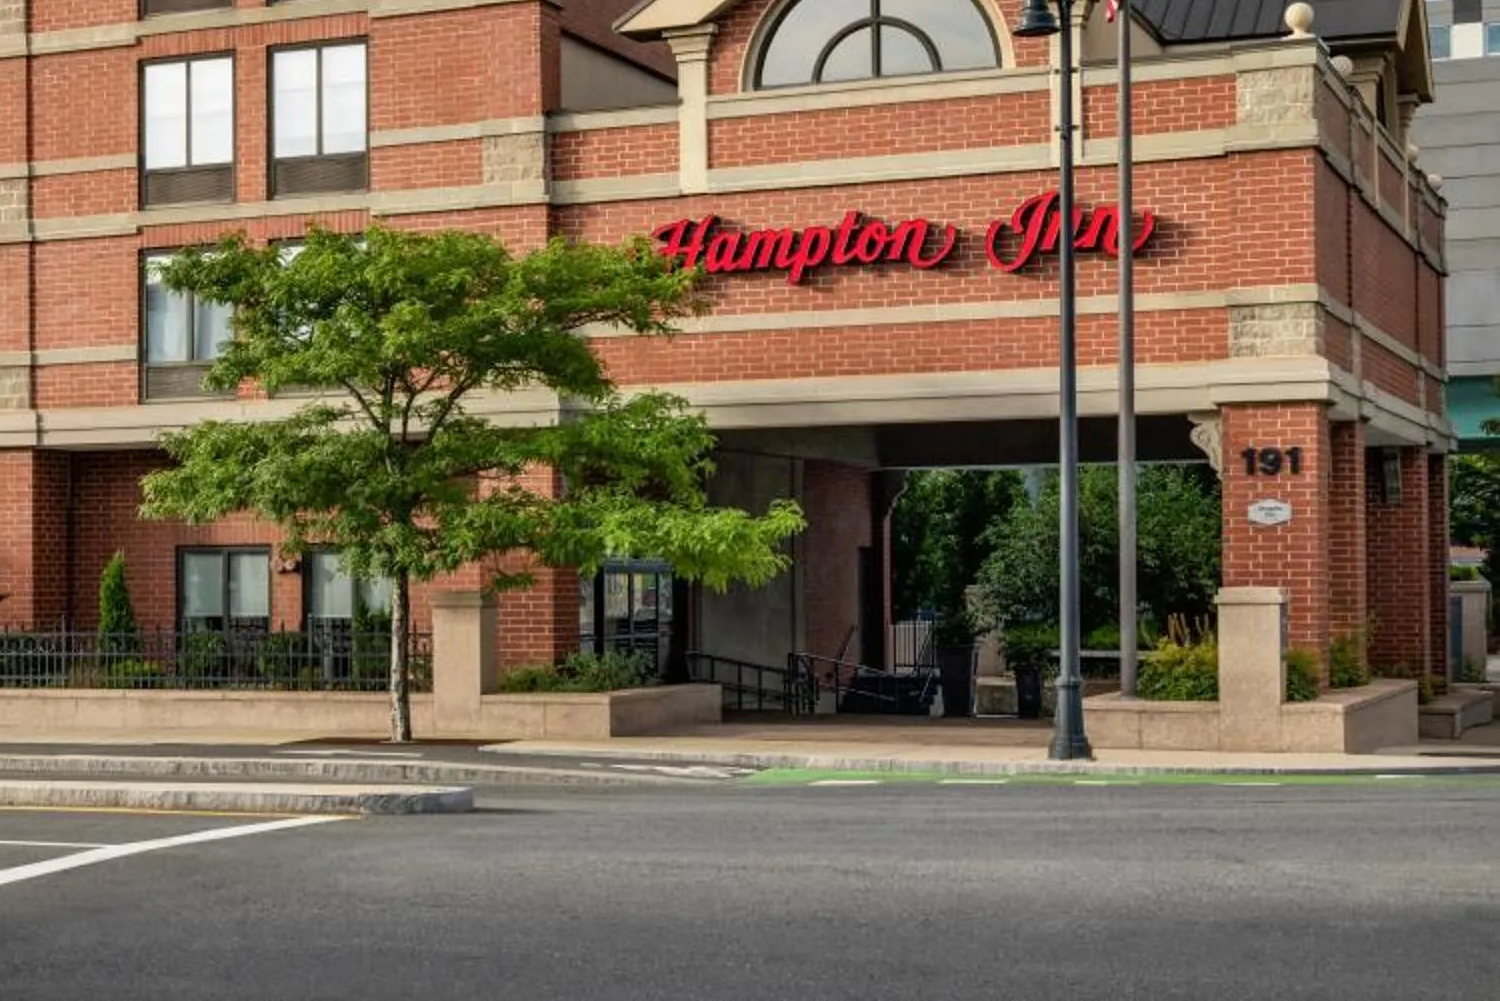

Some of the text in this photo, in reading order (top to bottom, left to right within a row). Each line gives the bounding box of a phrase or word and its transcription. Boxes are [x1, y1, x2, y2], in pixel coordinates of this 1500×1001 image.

[652, 189, 1155, 284] Hampton Inn
[1241, 447, 1302, 476] 191
